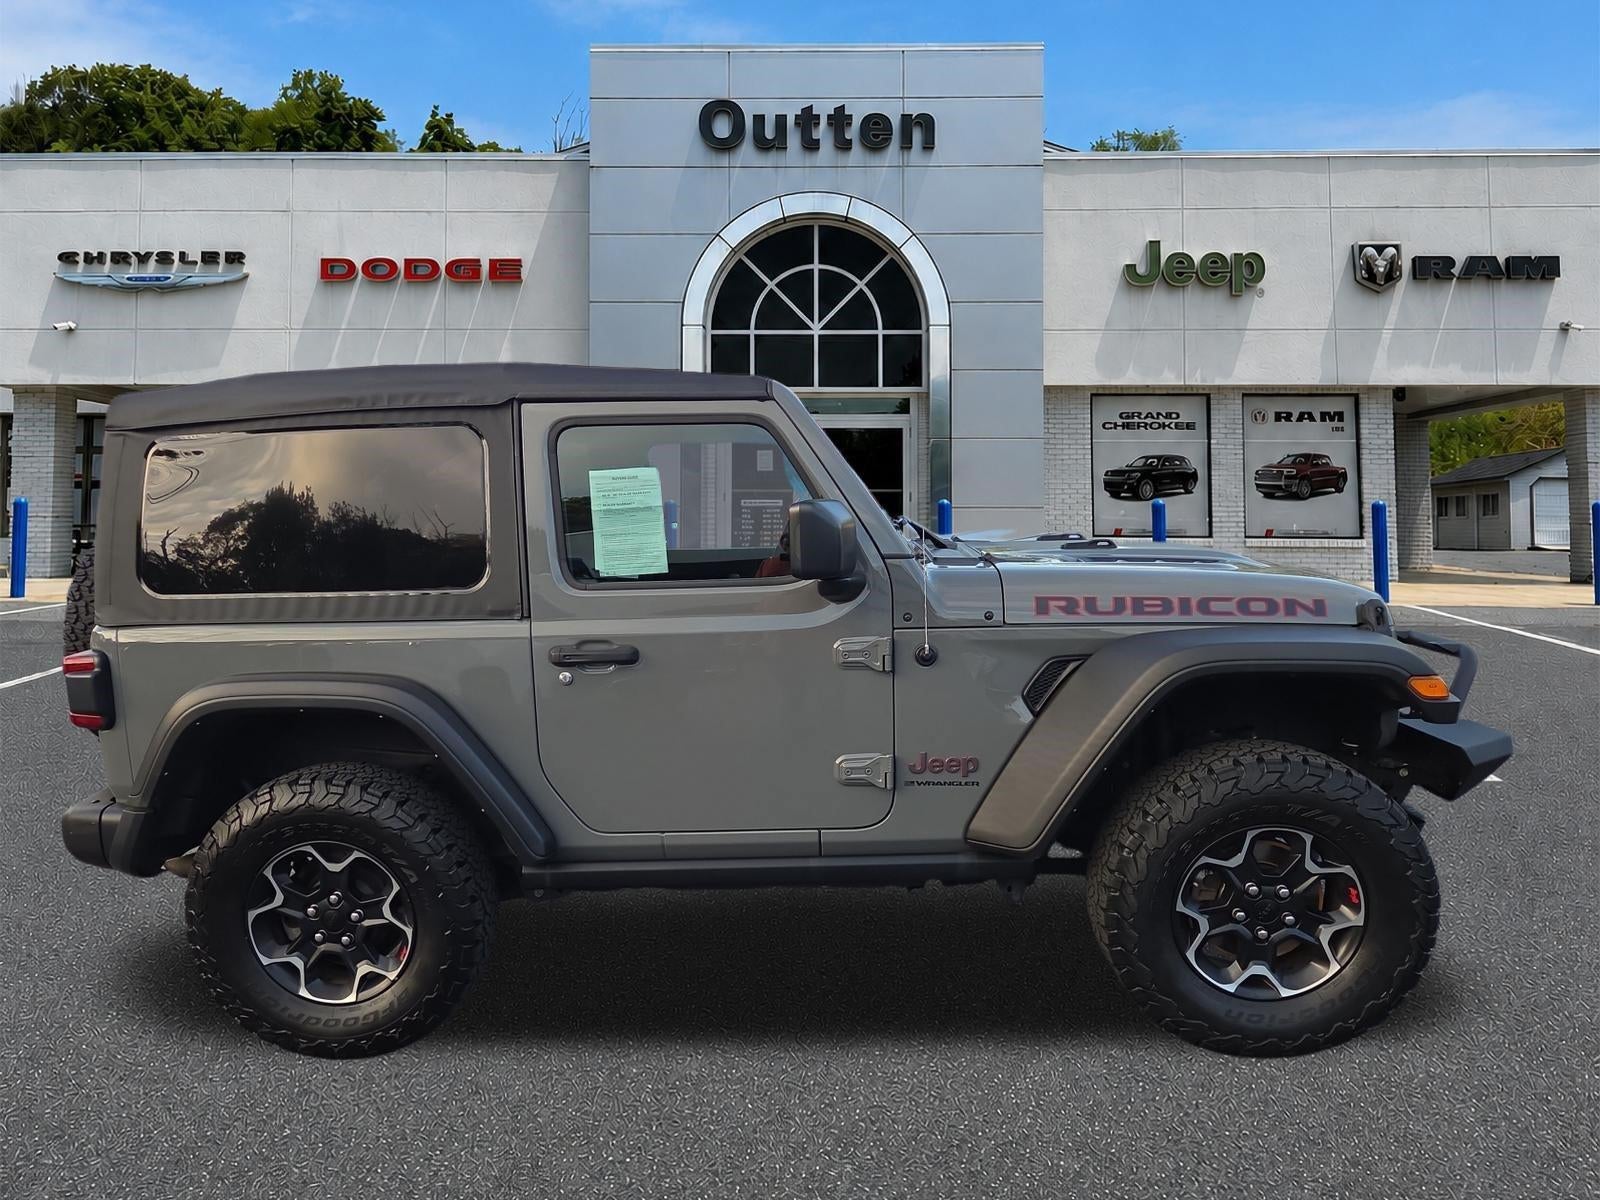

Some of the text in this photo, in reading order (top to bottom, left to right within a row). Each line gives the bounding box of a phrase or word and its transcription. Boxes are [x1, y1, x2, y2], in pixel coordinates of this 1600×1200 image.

[698, 98, 936, 151] Outten
[57, 250, 247, 266] CHRYSLER
[319, 257, 524, 283] DODGE
[1123, 239, 1267, 297] Jeep
[1411, 255, 1561, 280] RAM
[1101, 421, 1197, 431] CHEROKEE
[1118, 411, 1181, 420] GRAND
[1273, 410, 1345, 423] RAM
[1034, 595, 1328, 618] RUBICON
[907, 751, 980, 778] Jeep
